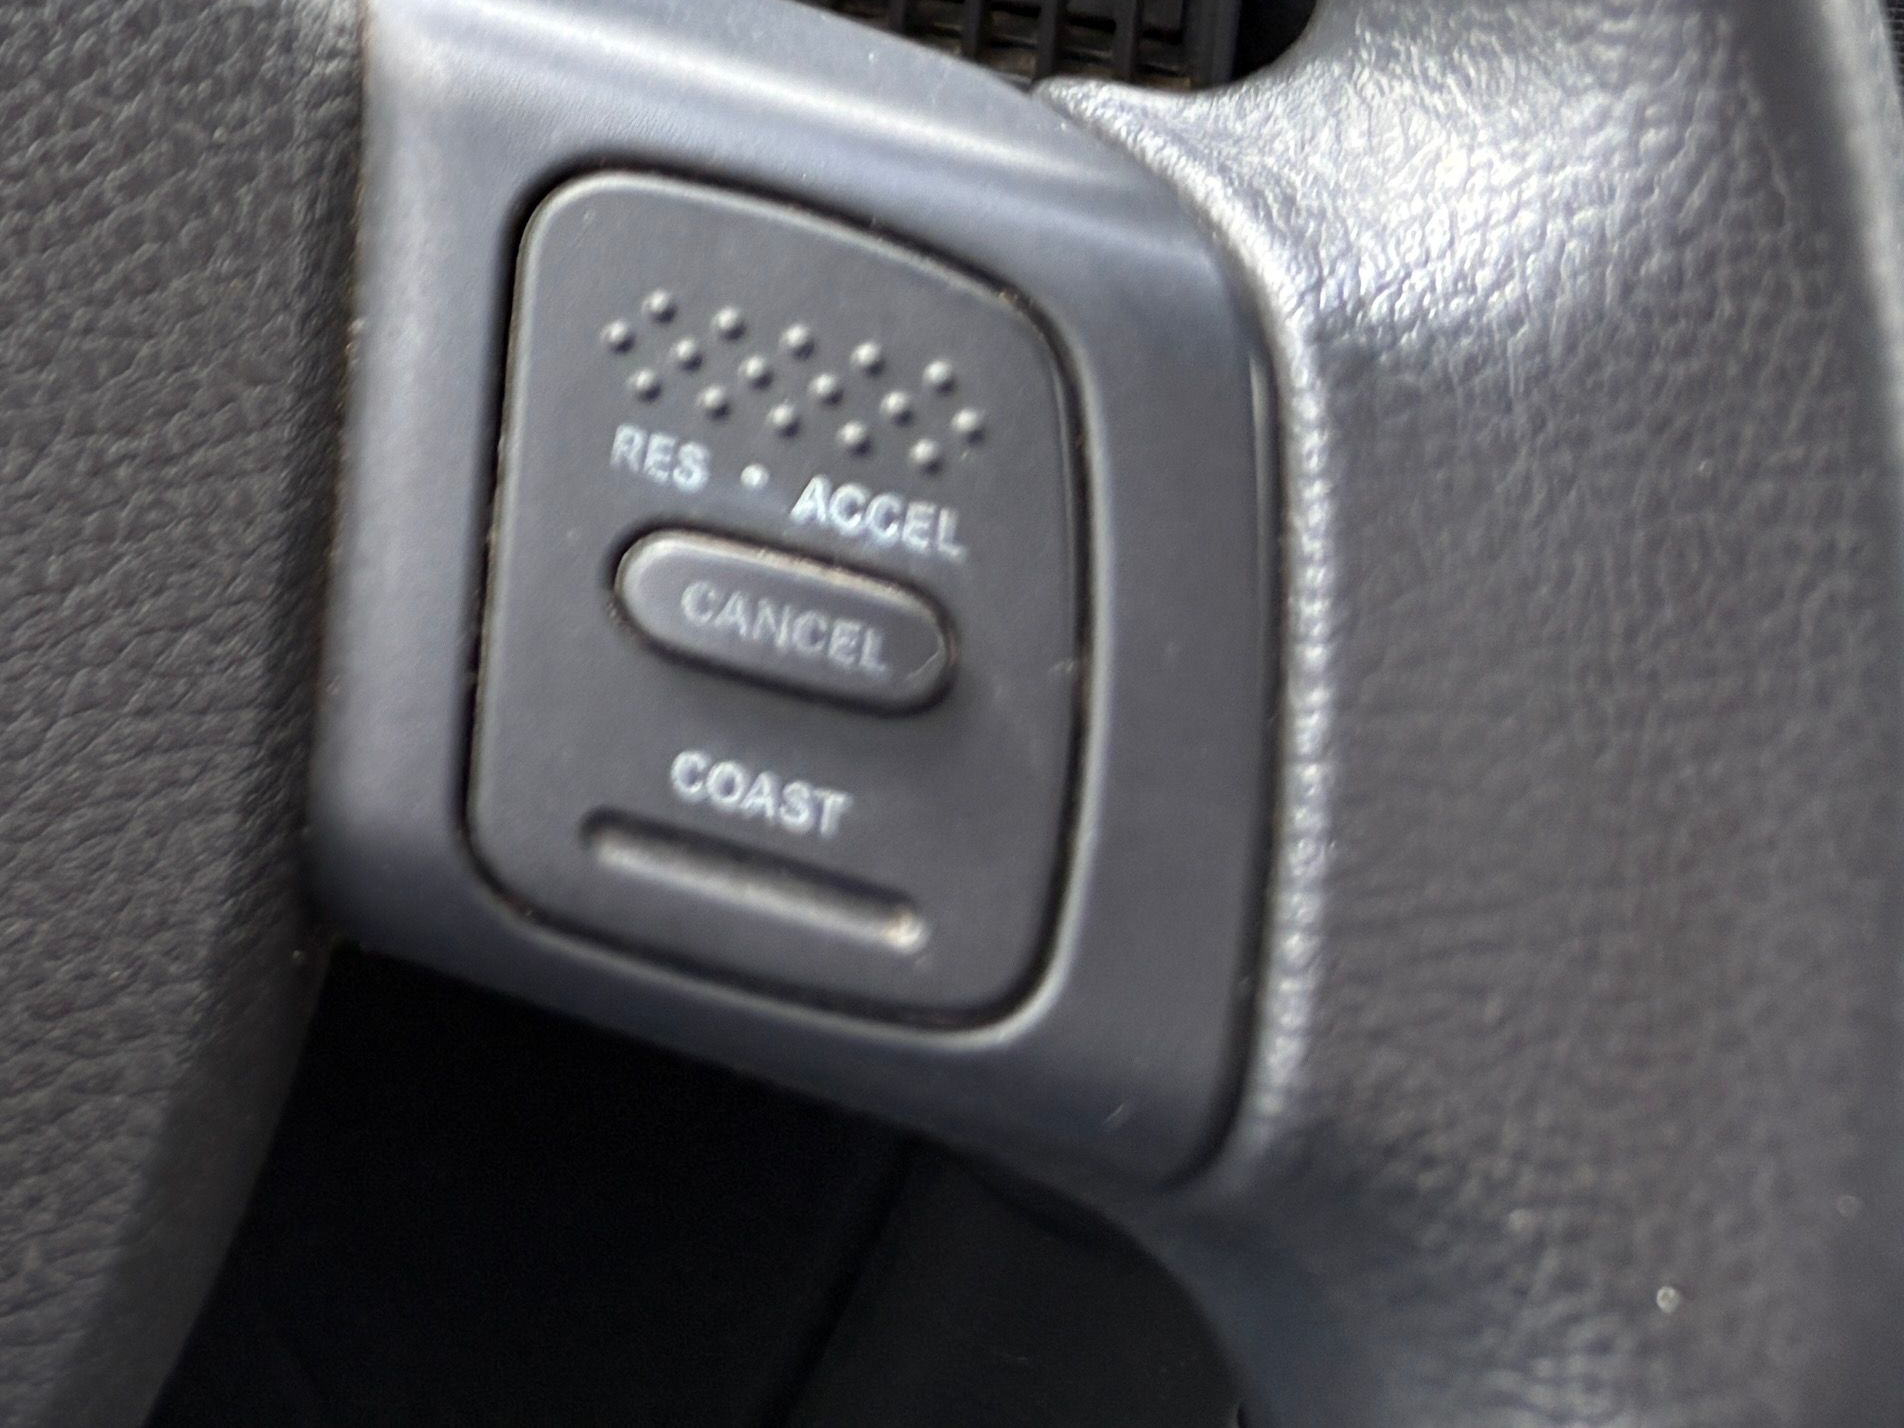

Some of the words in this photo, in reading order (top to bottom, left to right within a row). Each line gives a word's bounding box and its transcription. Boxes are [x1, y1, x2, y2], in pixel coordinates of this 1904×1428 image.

[610, 423, 710, 493] RES
[791, 473, 965, 562] ACCEL
[680, 579, 888, 674] CANCEL
[670, 749, 852, 841] COAST
